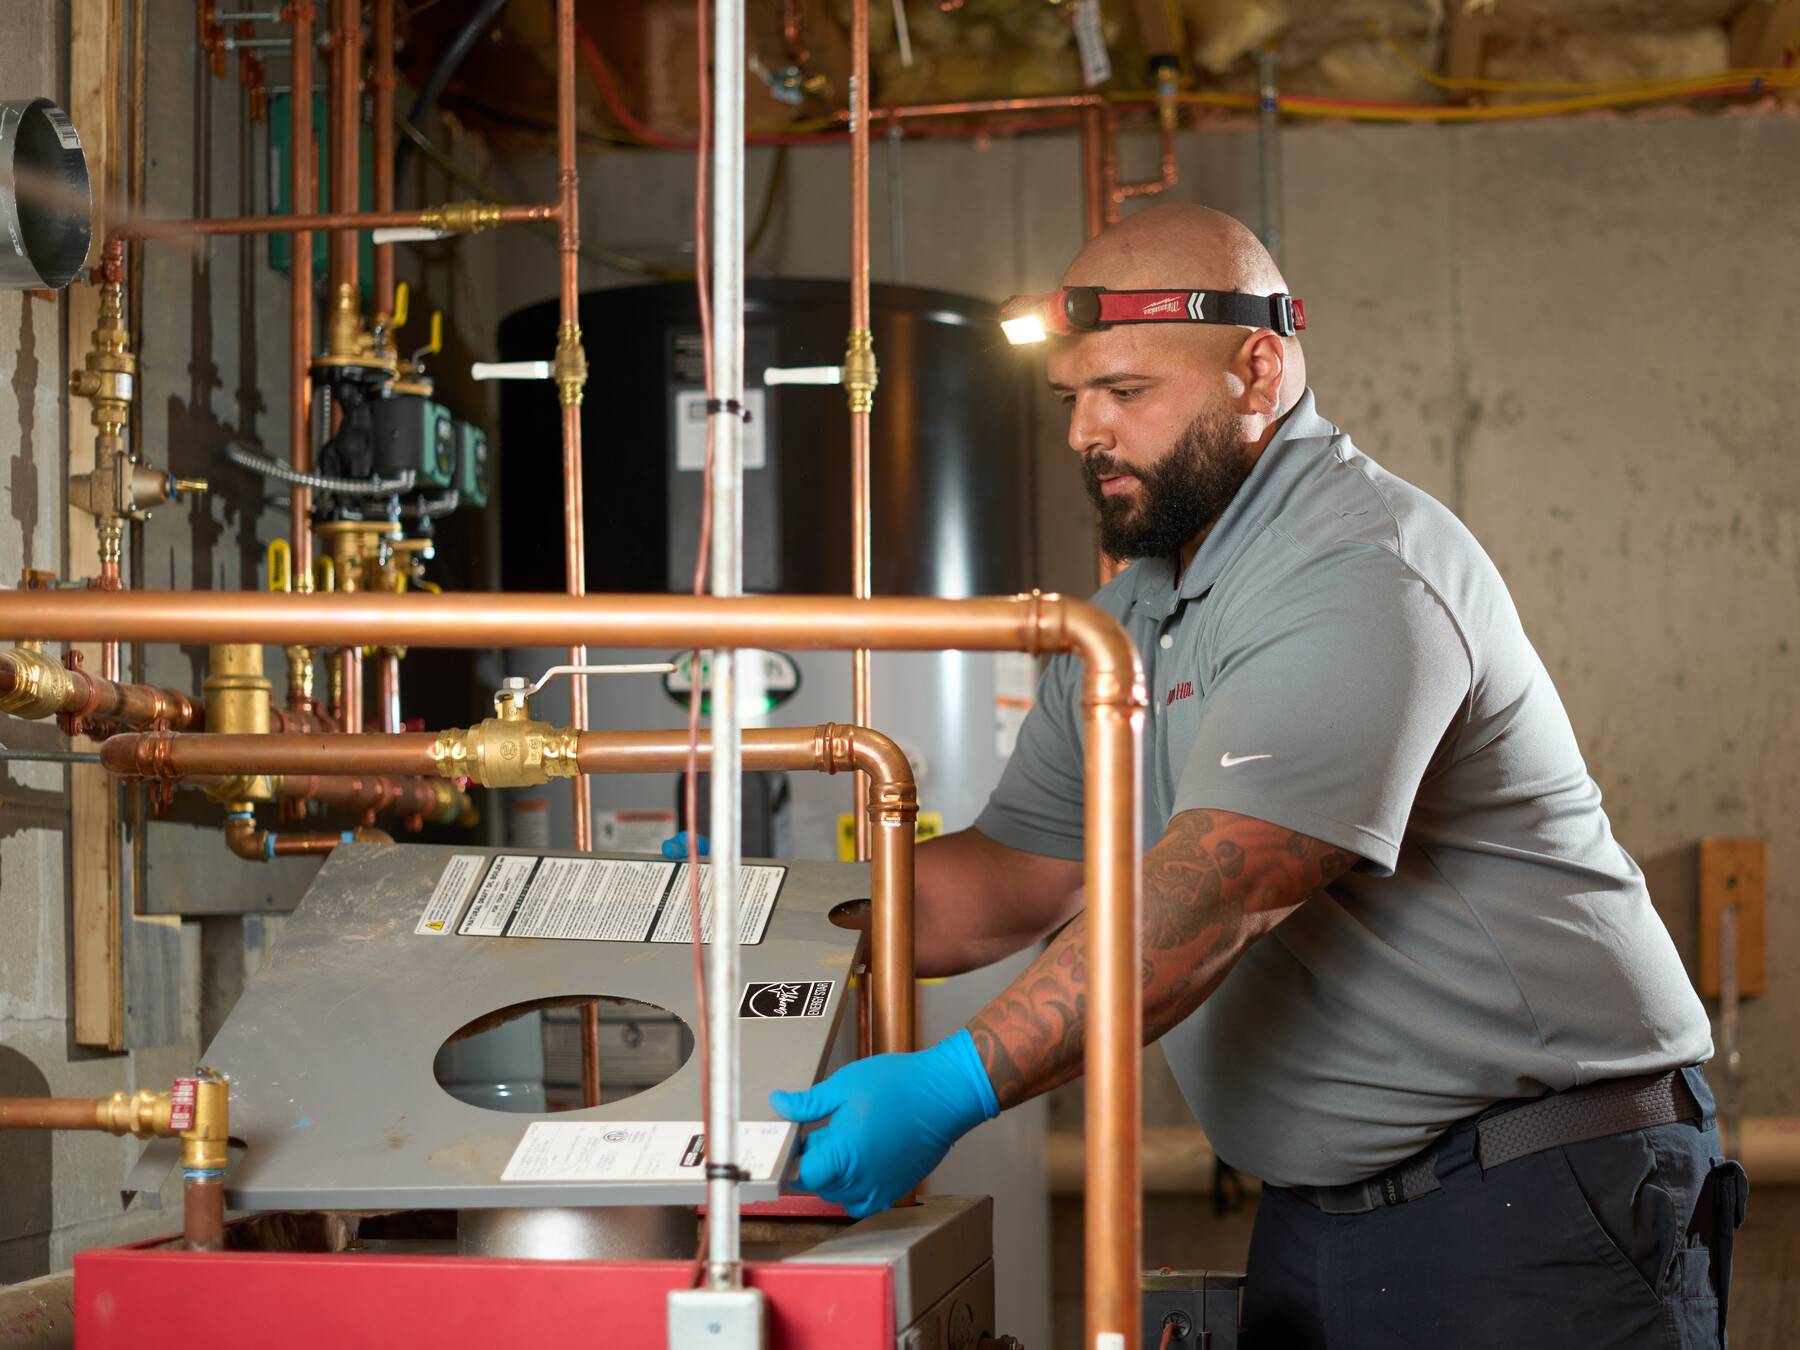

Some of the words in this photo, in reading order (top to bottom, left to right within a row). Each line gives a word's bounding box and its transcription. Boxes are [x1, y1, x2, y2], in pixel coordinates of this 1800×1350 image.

[1143, 300, 1181, 315] Milwaukee
[814, 982, 829, 996] STAR
[807, 996, 824, 1015] ENERGY
